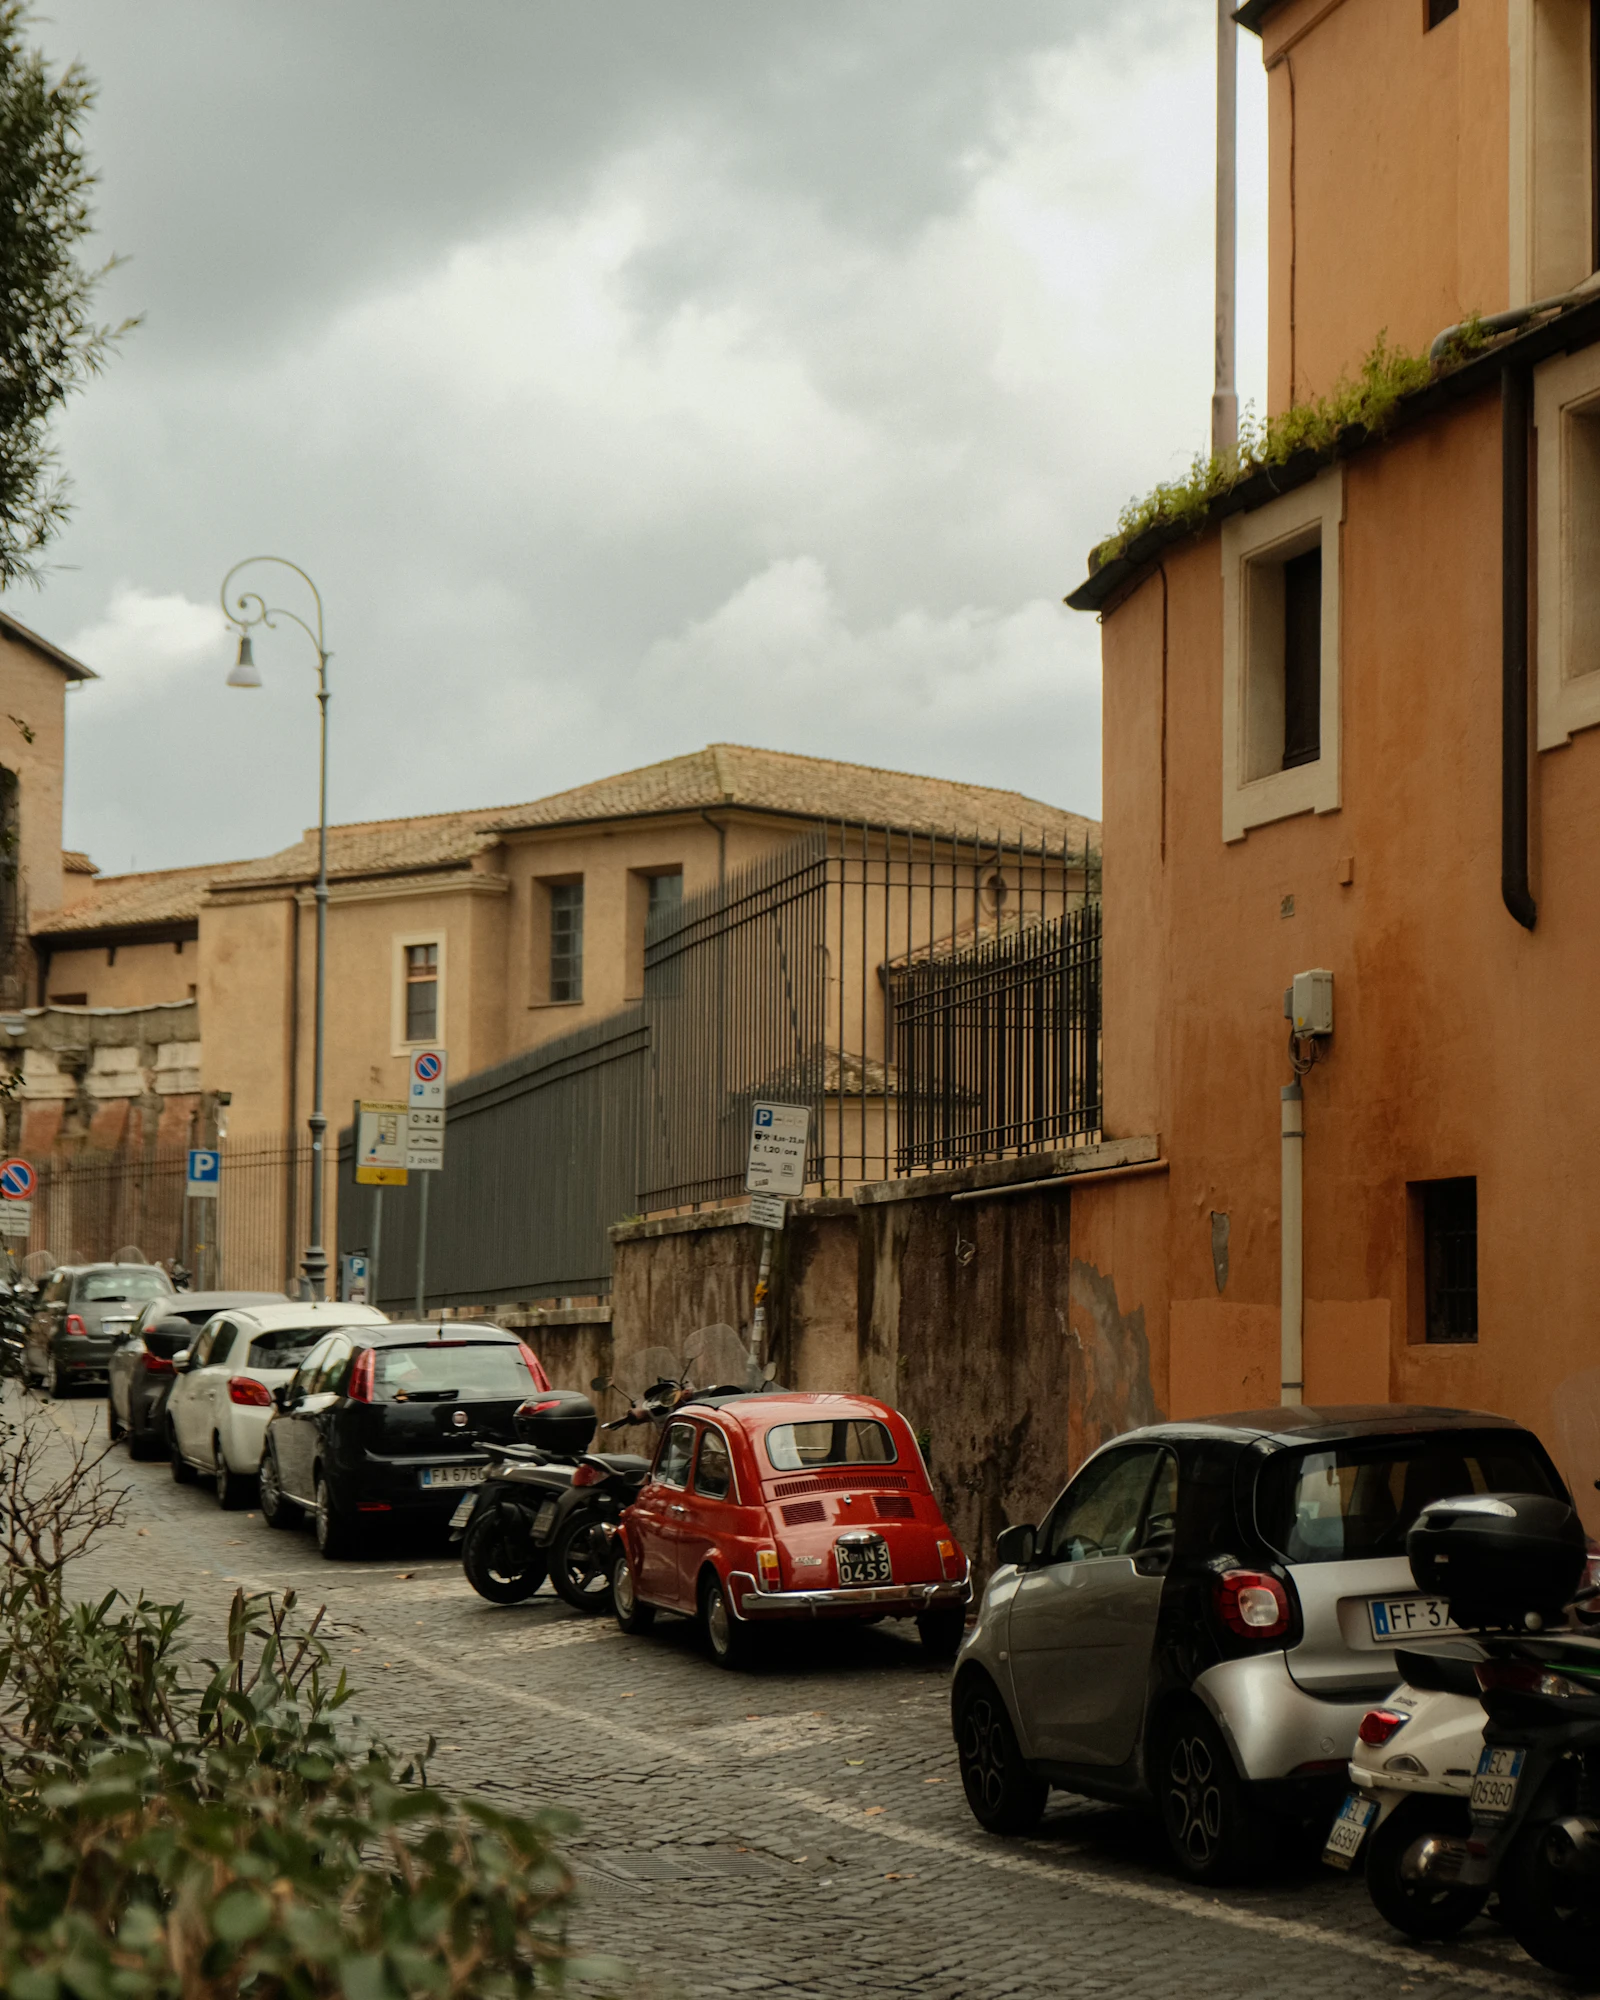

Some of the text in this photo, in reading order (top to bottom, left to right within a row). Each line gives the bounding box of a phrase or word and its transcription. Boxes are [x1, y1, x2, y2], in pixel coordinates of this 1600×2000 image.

[758, 1110, 771, 1125] P
[193, 1153, 215, 1178] P
[432, 1469, 449, 1482] FA
[840, 1561, 890, 1583] 0459
[1389, 1602, 1416, 1630] FF
[1488, 1751, 1507, 1774] EC
[1473, 1780, 1512, 1806] 05960
